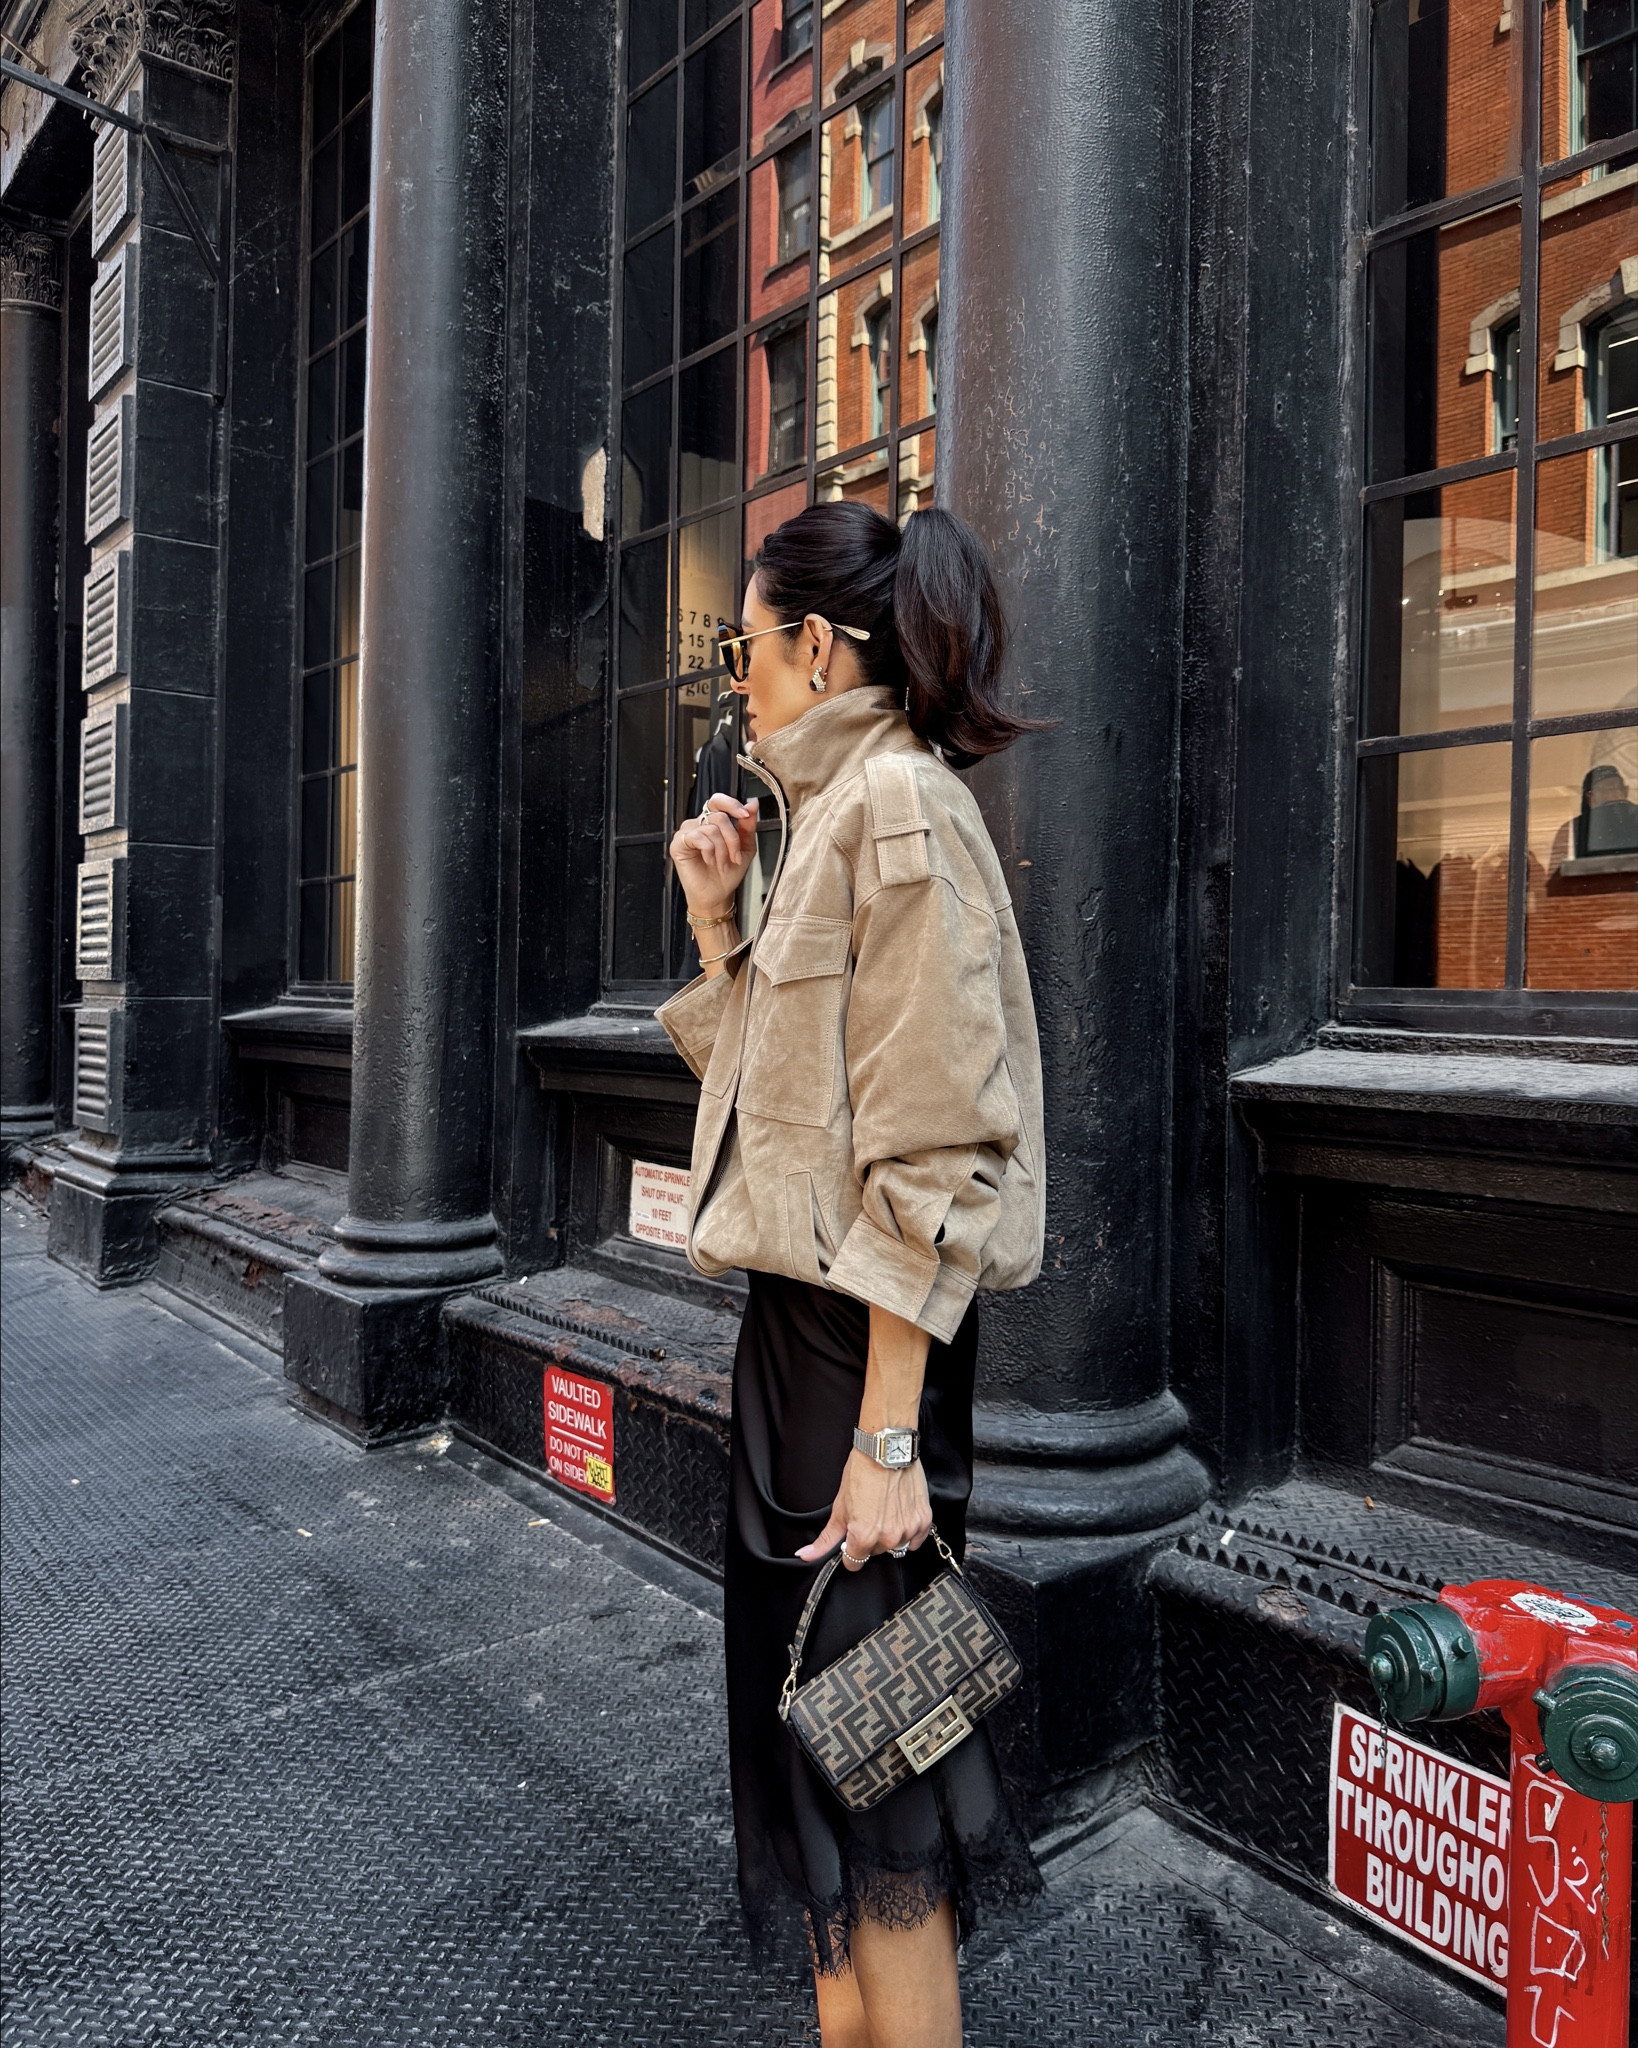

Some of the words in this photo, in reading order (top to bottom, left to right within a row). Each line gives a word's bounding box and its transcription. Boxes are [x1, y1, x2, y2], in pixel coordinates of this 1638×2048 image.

[689, 611, 697, 625] 7
[703, 614, 711, 628] 8
[688, 633, 705, 648] 15
[688, 655, 705, 670] 22
[634, 1166, 663, 1182] AUTOMATIC
[664, 1171, 691, 1187] SPRINKLE
[641, 1186, 655, 1198] SHUT
[656, 1189, 667, 1201] OFF
[667, 1193, 684, 1205] VALVE
[658, 1209, 672, 1222] FEET
[635, 1222, 661, 1240] OPPOSITE
[662, 1229, 675, 1243] THIS
[551, 1374, 601, 1409] VAULTED
[548, 1400, 607, 1440] SIDEWALK
[550, 1435, 563, 1453] DO
[563, 1439, 582, 1462] NOT
[550, 1455, 563, 1474] ON
[1337, 1775, 1511, 1912] THROUGHO
[1365, 1852, 1510, 1980] BUILDING
